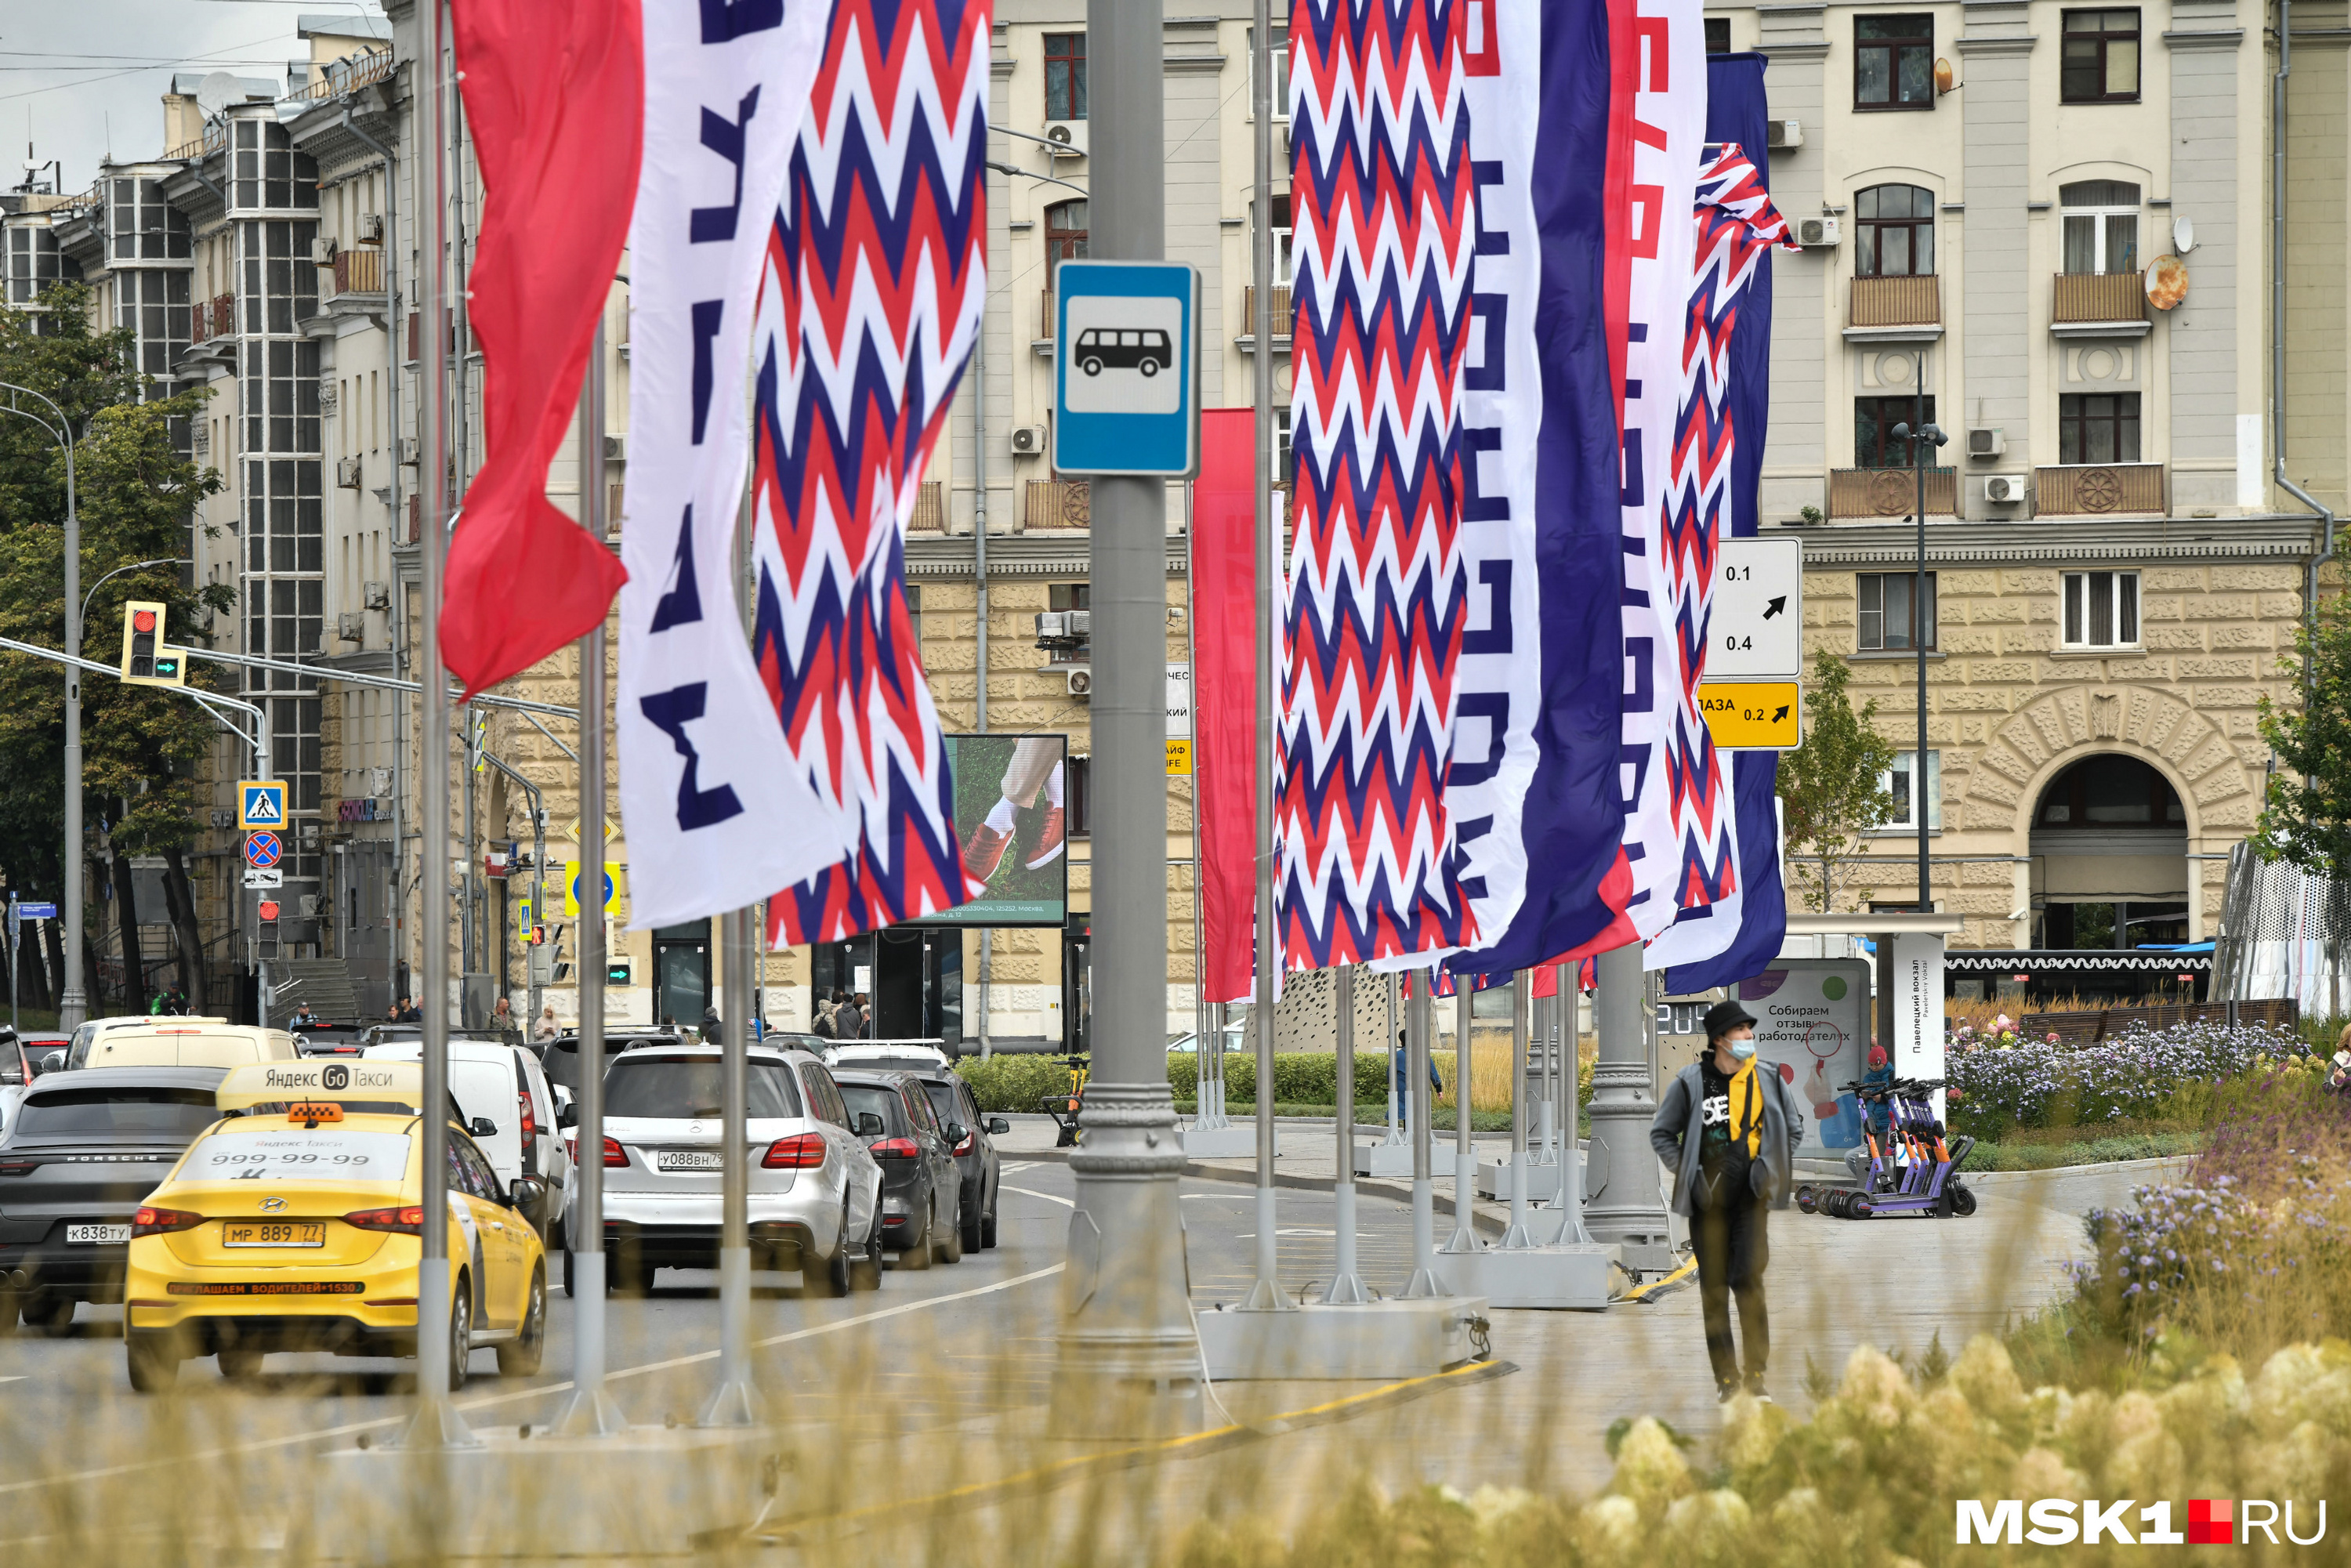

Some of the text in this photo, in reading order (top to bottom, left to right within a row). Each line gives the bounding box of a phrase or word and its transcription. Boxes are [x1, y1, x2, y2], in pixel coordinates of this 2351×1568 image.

[1726, 566, 1750, 581] 0.1
[1726, 636, 1752, 650] 0.4
[1744, 708, 1764, 721] 0.2
[1769, 1005, 1829, 1017] Собираем
[1911, 994, 1922, 1054] Павелецкий
[1759, 1031, 1849, 1042] работодателях
[266, 1068, 393, 1088] Яндекс Go Такси
[255, 1139, 343, 1148] Яндекс Такси
[211, 1153, 370, 1166] 999-99-99
[261, 1226, 292, 1241] 889
[302, 1225, 319, 1237] 77
[169, 1284, 245, 1295] ПРИГЛАШАЕМ
